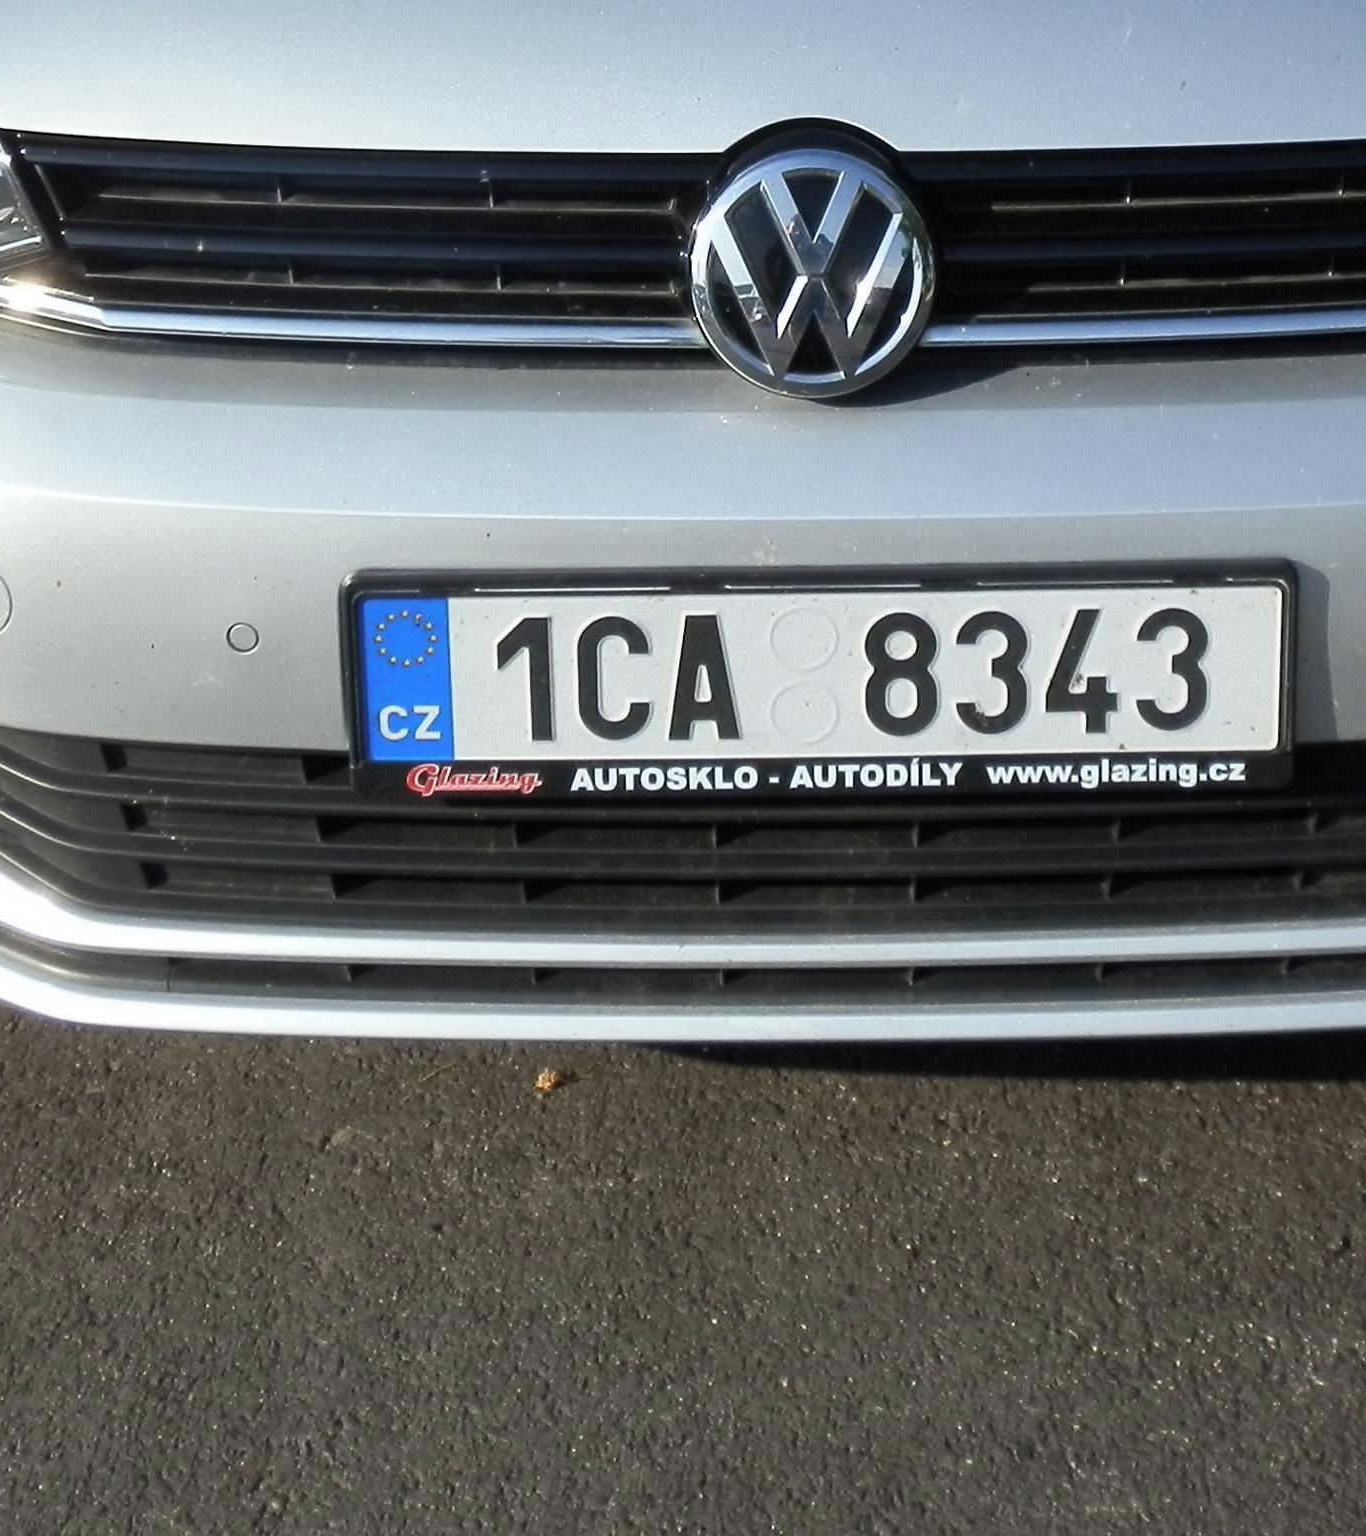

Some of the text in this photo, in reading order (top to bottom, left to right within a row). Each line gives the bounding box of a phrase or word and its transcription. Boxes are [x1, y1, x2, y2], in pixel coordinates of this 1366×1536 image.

[496, 607, 1209, 742] 1CA 8343
[378, 705, 442, 740] CZ
[406, 764, 541, 798] Glazing
[570, 766, 758, 791] AUTOSKLO
[789, 757, 963, 790] AUTODÍLY
[987, 757, 1246, 789] www.glazing.cz
